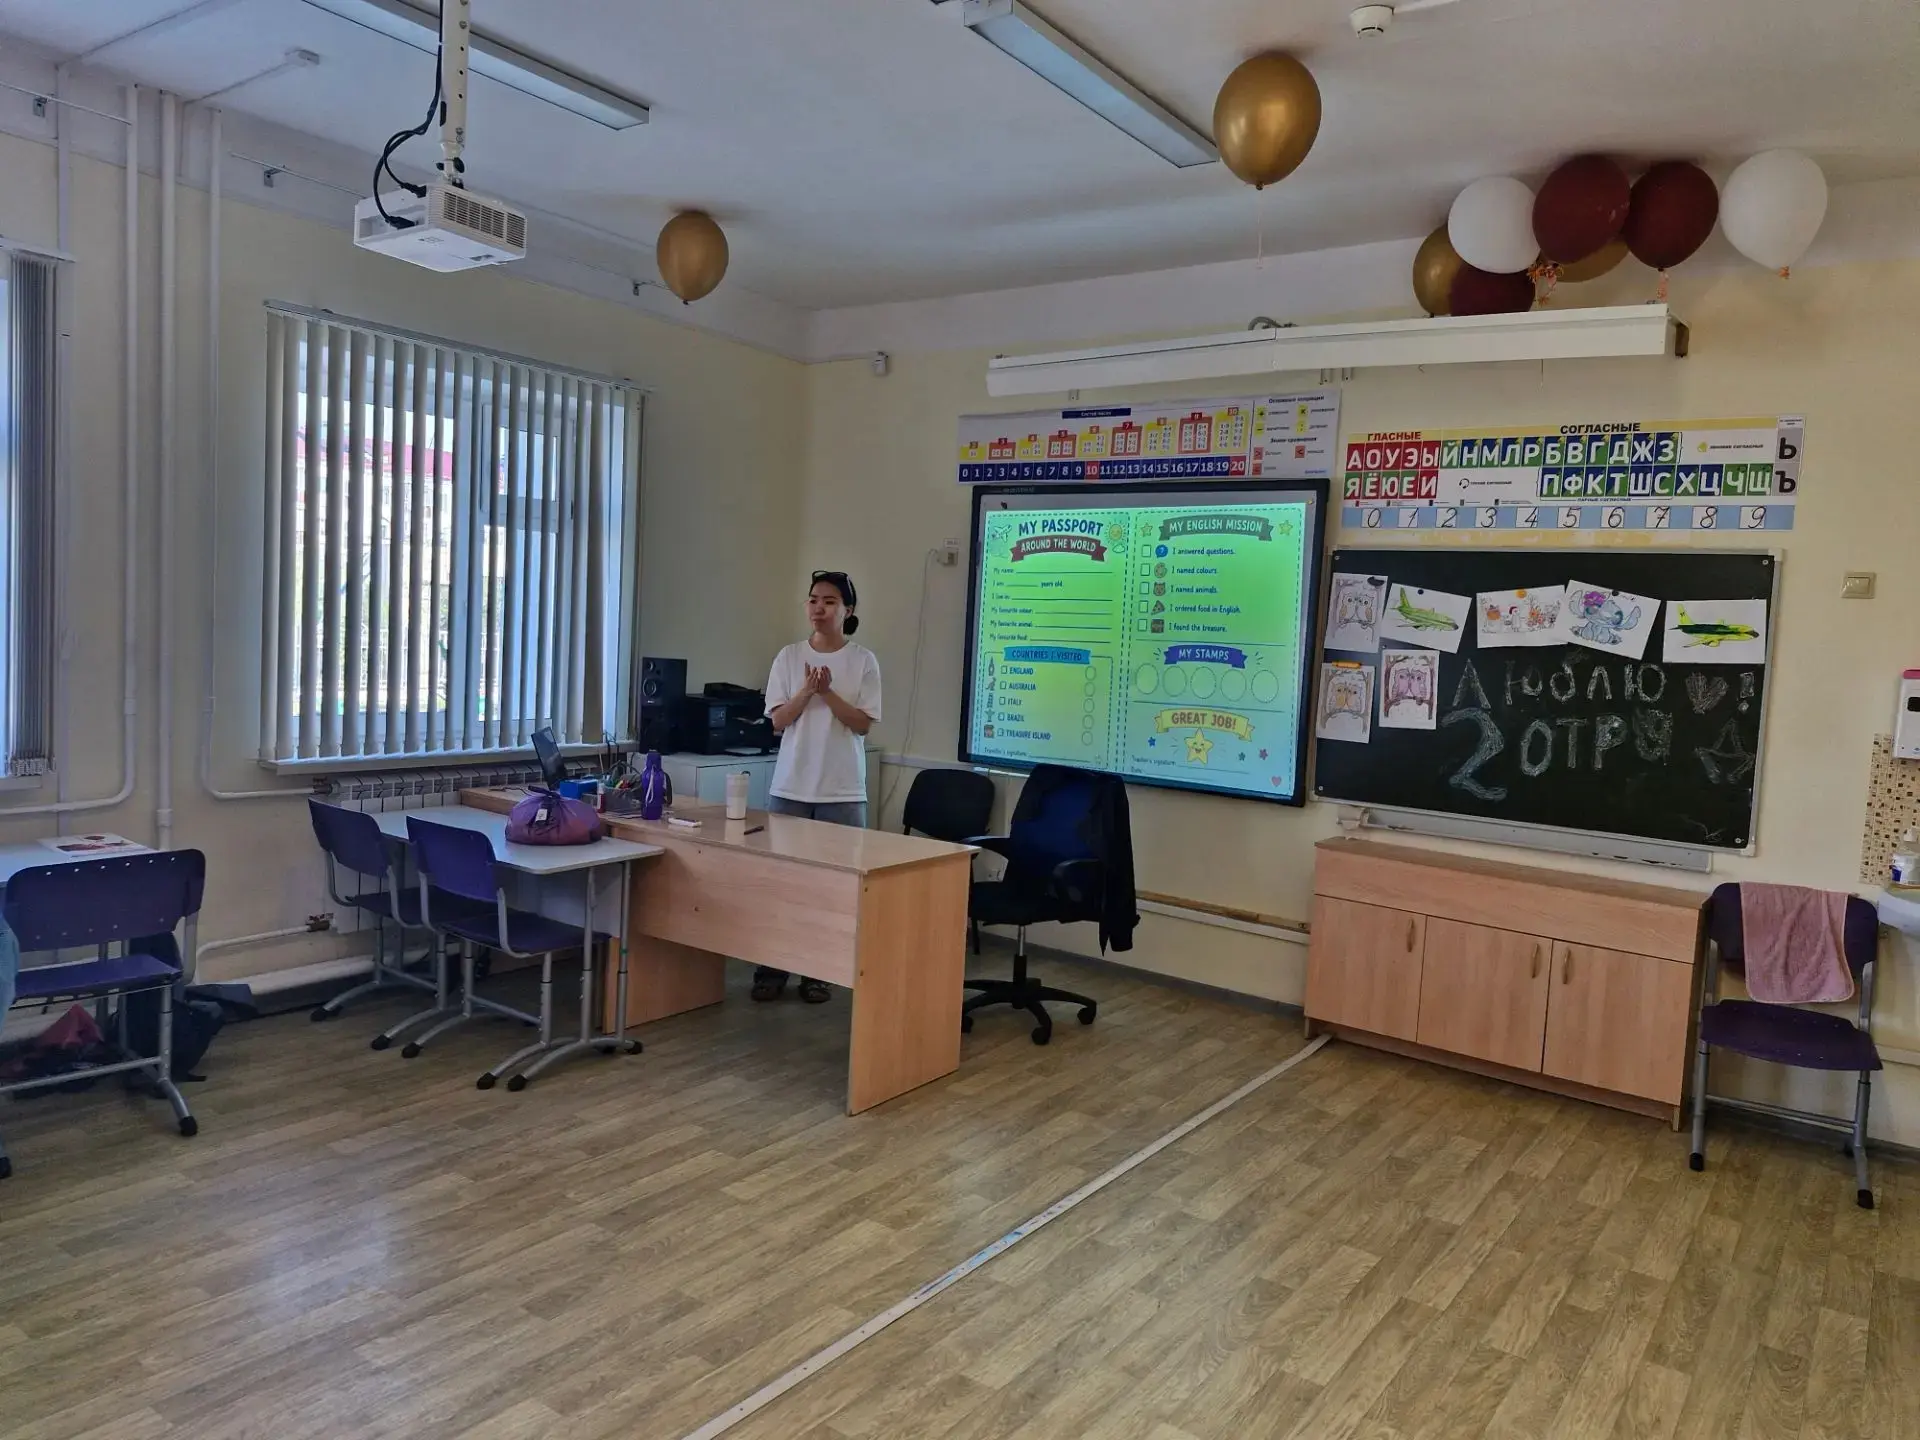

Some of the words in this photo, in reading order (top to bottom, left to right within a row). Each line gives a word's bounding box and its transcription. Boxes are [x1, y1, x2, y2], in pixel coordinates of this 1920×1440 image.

[1560, 422, 1641, 435] СОГЛАСНЫЕ
[1367, 431, 1421, 442] ГЛАСНЫЕ
[1348, 450, 1361, 469] А
[1366, 449, 1380, 468] О
[1385, 449, 1400, 468] У
[1404, 448, 1418, 467] Э
[1421, 447, 1439, 467] Ы
[1442, 443, 1459, 466] Й
[1462, 445, 1478, 466] Н
[1481, 445, 1499, 466] М
[1501, 445, 1520, 466] Л
[1523, 445, 1540, 465] Р
[1545, 444, 1561, 464] Б
[1568, 443, 1583, 463] В
[1590, 442, 1605, 462] Г
[1610, 442, 1630, 464] Д
[1632, 440, 1653, 461] Ж
[1657, 440, 1674, 461] З
[1779, 437, 1797, 459] Ь
[963, 469, 968, 477] 0
[975, 469, 980, 477] 1
[987, 468, 993, 477] 2
[999, 468, 1005, 477] 3
[1011, 468, 1018, 476] 4
[1024, 467, 1030, 476] 5
[1036, 467, 1042, 476] 6
[1049, 467, 1055, 476] 7
[1062, 467, 1068, 475] 8
[1075, 467, 1081, 475] 9
[1087, 466, 1098, 475] 10
[1100, 466, 1111, 474] 11
[1114, 465, 1126, 474] 12
[1128, 465, 1140, 474] 13
[1142, 464, 1154, 474] 14
[1157, 464, 1169, 474] 15
[1171, 463, 1184, 473] 16
[1186, 463, 1199, 473] 17
[1201, 462, 1214, 472] 18
[1216, 462, 1229, 472] 19
[1232, 461, 1245, 471] 20
[1345, 478, 1360, 496] Я
[1365, 472, 1378, 496] Ё
[1381, 476, 1399, 496] Ю
[1401, 476, 1415, 496] Е
[1419, 476, 1437, 496] И
[1543, 474, 1558, 495] П
[1564, 473, 1583, 495] Ф
[1588, 474, 1604, 494] К
[1610, 473, 1626, 494] Т
[1630, 472, 1650, 495] Ш
[1654, 472, 1670, 493] С
[1677, 472, 1695, 493] Х
[1700, 471, 1719, 496] Ц
[1727, 471, 1744, 492] Ч
[1749, 471, 1772, 494] Щ
[1775, 470, 1796, 493] Ъ
[1367, 508, 1381, 528] 0
[1407, 508, 1419, 528] 1
[1442, 507, 1458, 528] 2
[1481, 507, 1497, 528] 3
[1524, 507, 1538, 528] 4
[1562, 507, 1581, 528] 5
[1608, 506, 1624, 528] 6
[1653, 506, 1670, 528] 7
[1700, 506, 1718, 528] 8
[1748, 506, 1766, 528] 9
[1019, 520, 1038, 536] MY
[1042, 519, 1104, 536] PASSPORT
[1170, 521, 1186, 532] MY
[1187, 519, 1223, 531] ENGLISH
[1225, 520, 1263, 532] MISSION
[1021, 539, 1051, 552] AROUND
[1054, 539, 1067, 549] THE
[1070, 540, 1096, 552] WORLD
[1178, 547, 1205, 555] answered
[1206, 548, 1236, 558] questions.
[1176, 566, 1195, 574] named
[1175, 605, 1197, 613] ordered
[1197, 605, 1210, 613] food
[1174, 623, 1190, 631] found
[1191, 623, 1201, 631] the
[1012, 649, 1049, 660] COUNTRIES
[1056, 651, 1082, 661] VISITED
[1178, 649, 1192, 658] MY
[1195, 649, 1230, 661] STAMPS
[1009, 683, 1037, 691] AUSTRALIA
[1007, 714, 1025, 722] BRAZIL
[1171, 711, 1208, 725] GREAT
[1210, 714, 1237, 730] JOB!
[1006, 729, 1031, 739] TREASURE
[1032, 731, 1051, 740] ISLAND
[1441, 707, 1505, 801] 2
